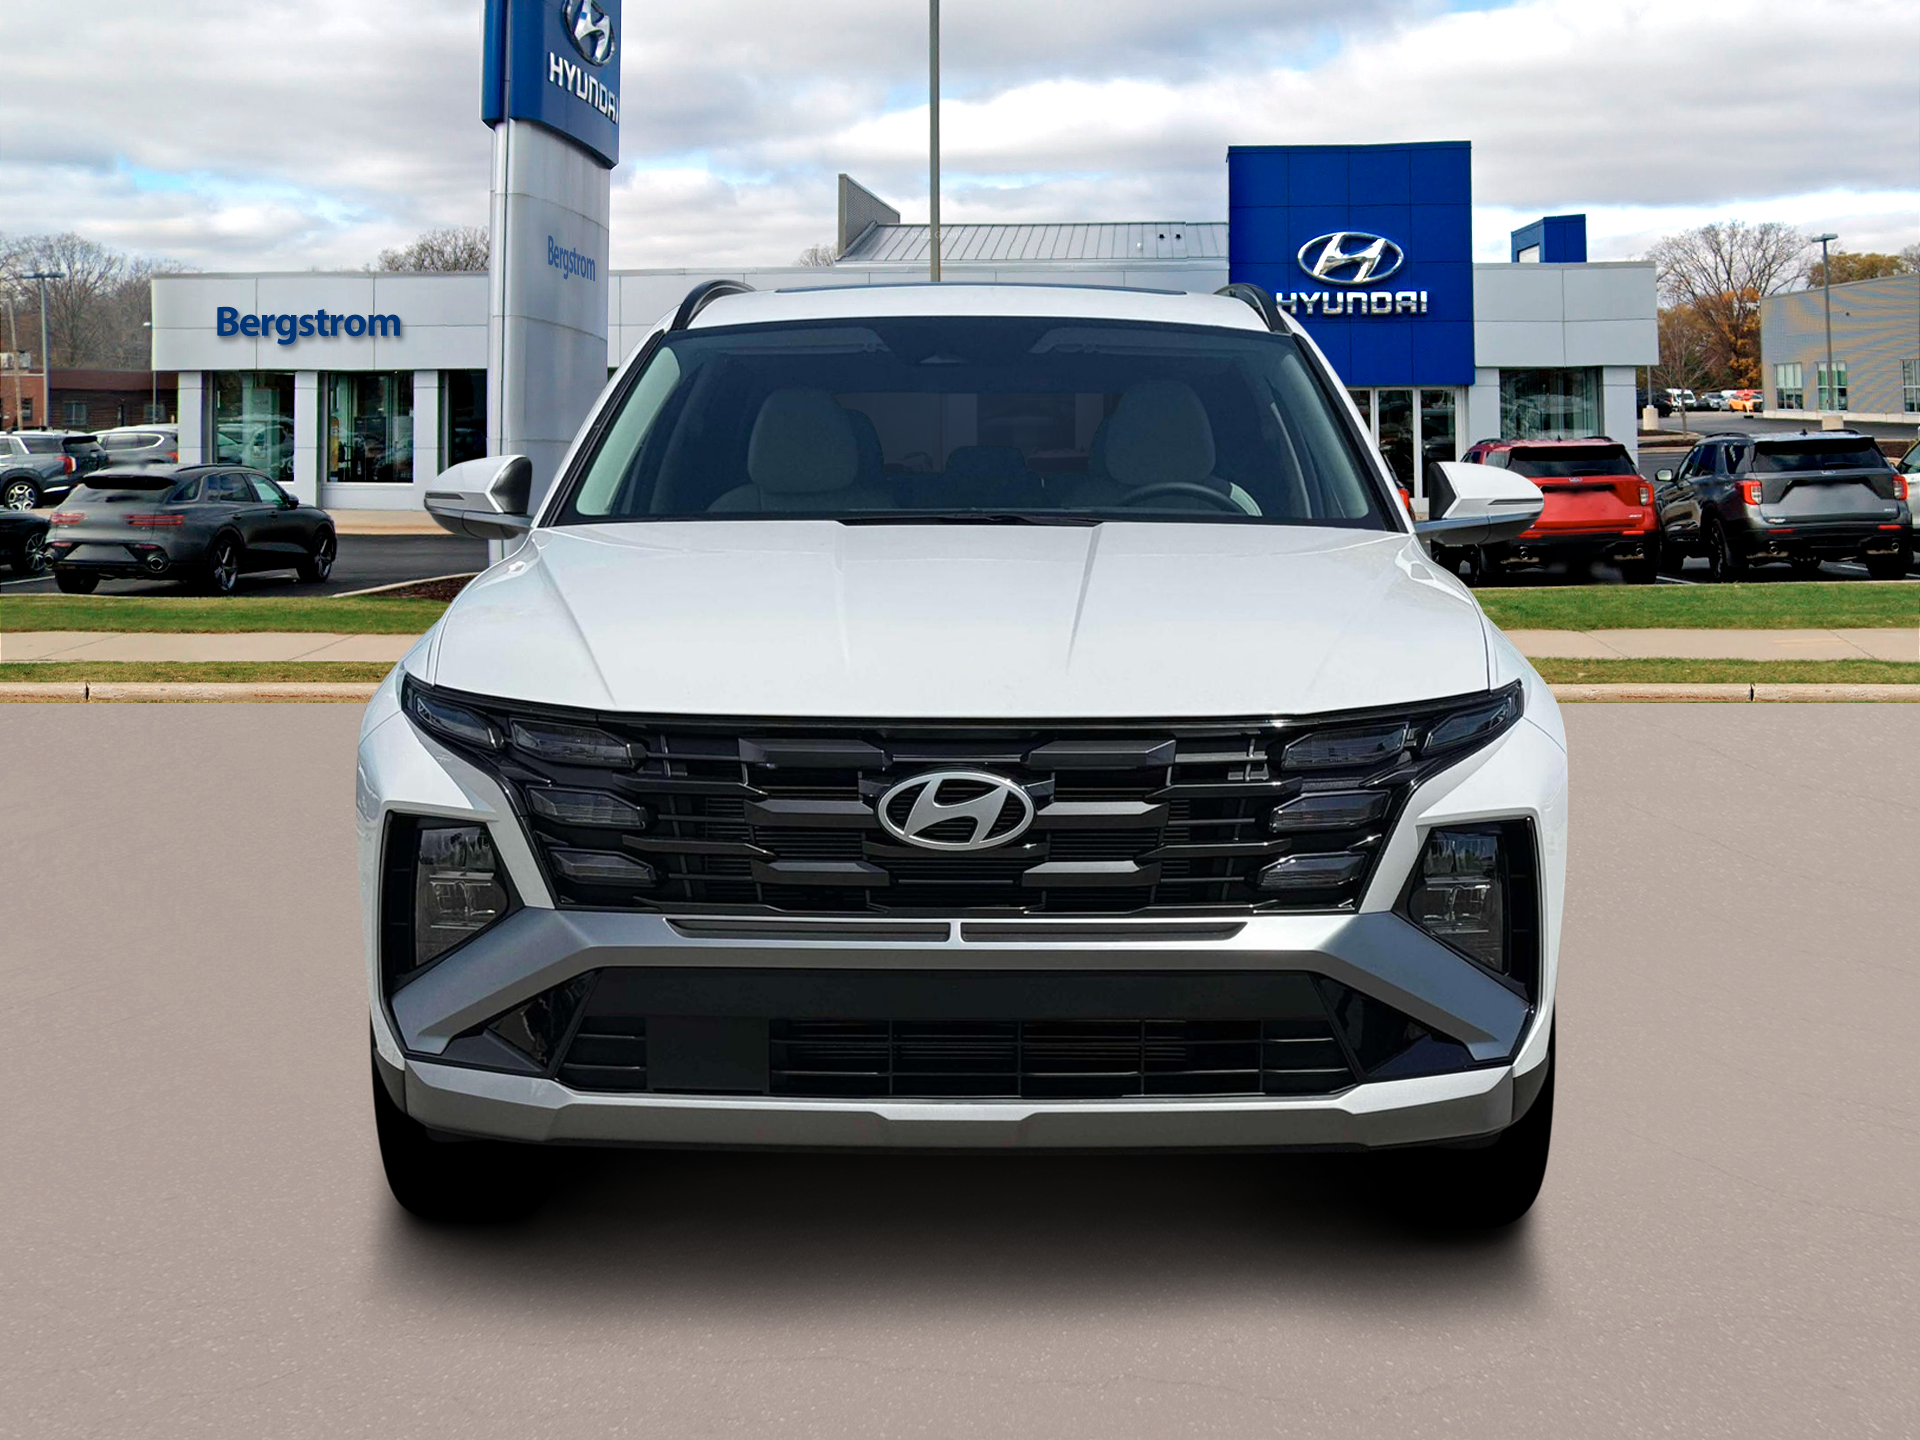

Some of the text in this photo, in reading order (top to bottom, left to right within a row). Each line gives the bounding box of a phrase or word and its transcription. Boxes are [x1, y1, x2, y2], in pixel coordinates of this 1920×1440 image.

[549, 52, 619, 124] HYUNDAI
[548, 235, 596, 282] Bergstrom
[1275, 291, 1428, 315] HYUNDAI
[216, 306, 401, 346] Bergstrom
